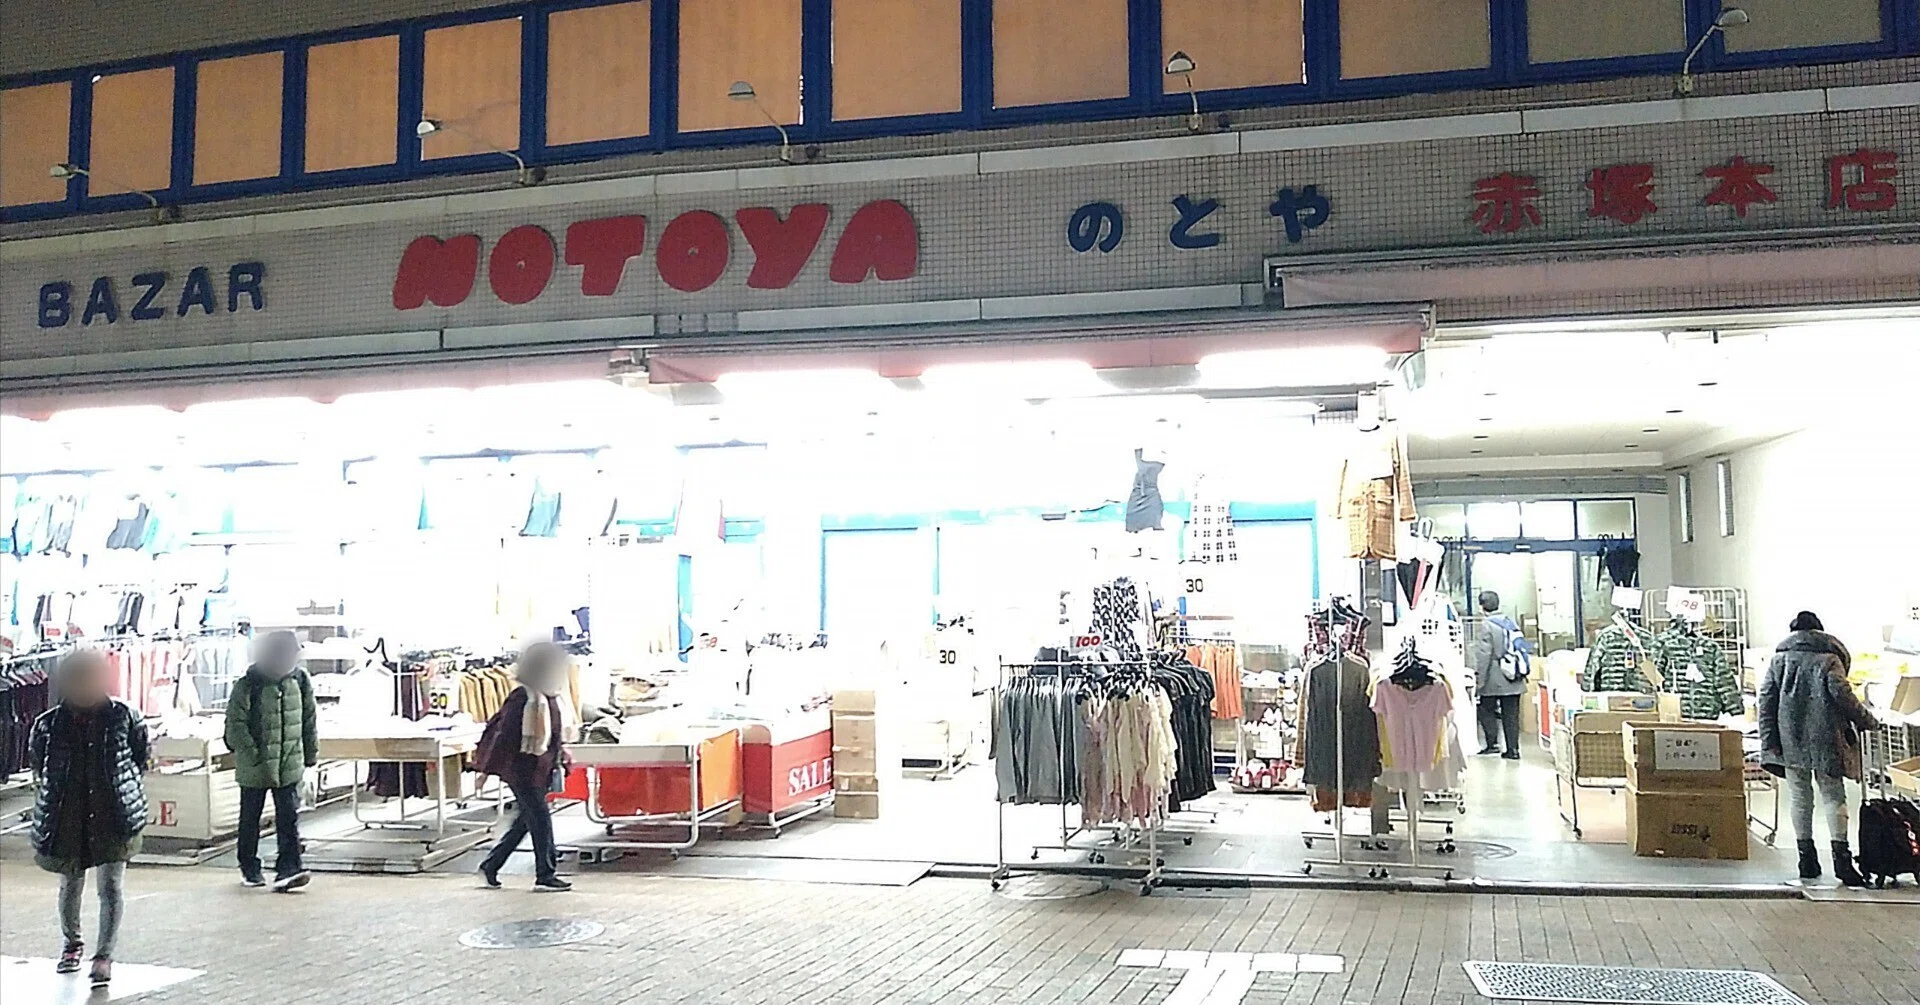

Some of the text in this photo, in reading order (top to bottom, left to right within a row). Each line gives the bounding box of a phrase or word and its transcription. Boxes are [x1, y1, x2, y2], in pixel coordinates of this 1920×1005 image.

[1067, 147, 1898, 252] のとや 赤塚本店
[38, 199, 918, 328] BAZAR NOTOYA
[1185, 578, 1204, 593] 30
[1075, 635, 1101, 648] 100
[939, 649, 956, 664] 30
[788, 757, 832, 797] SALE
